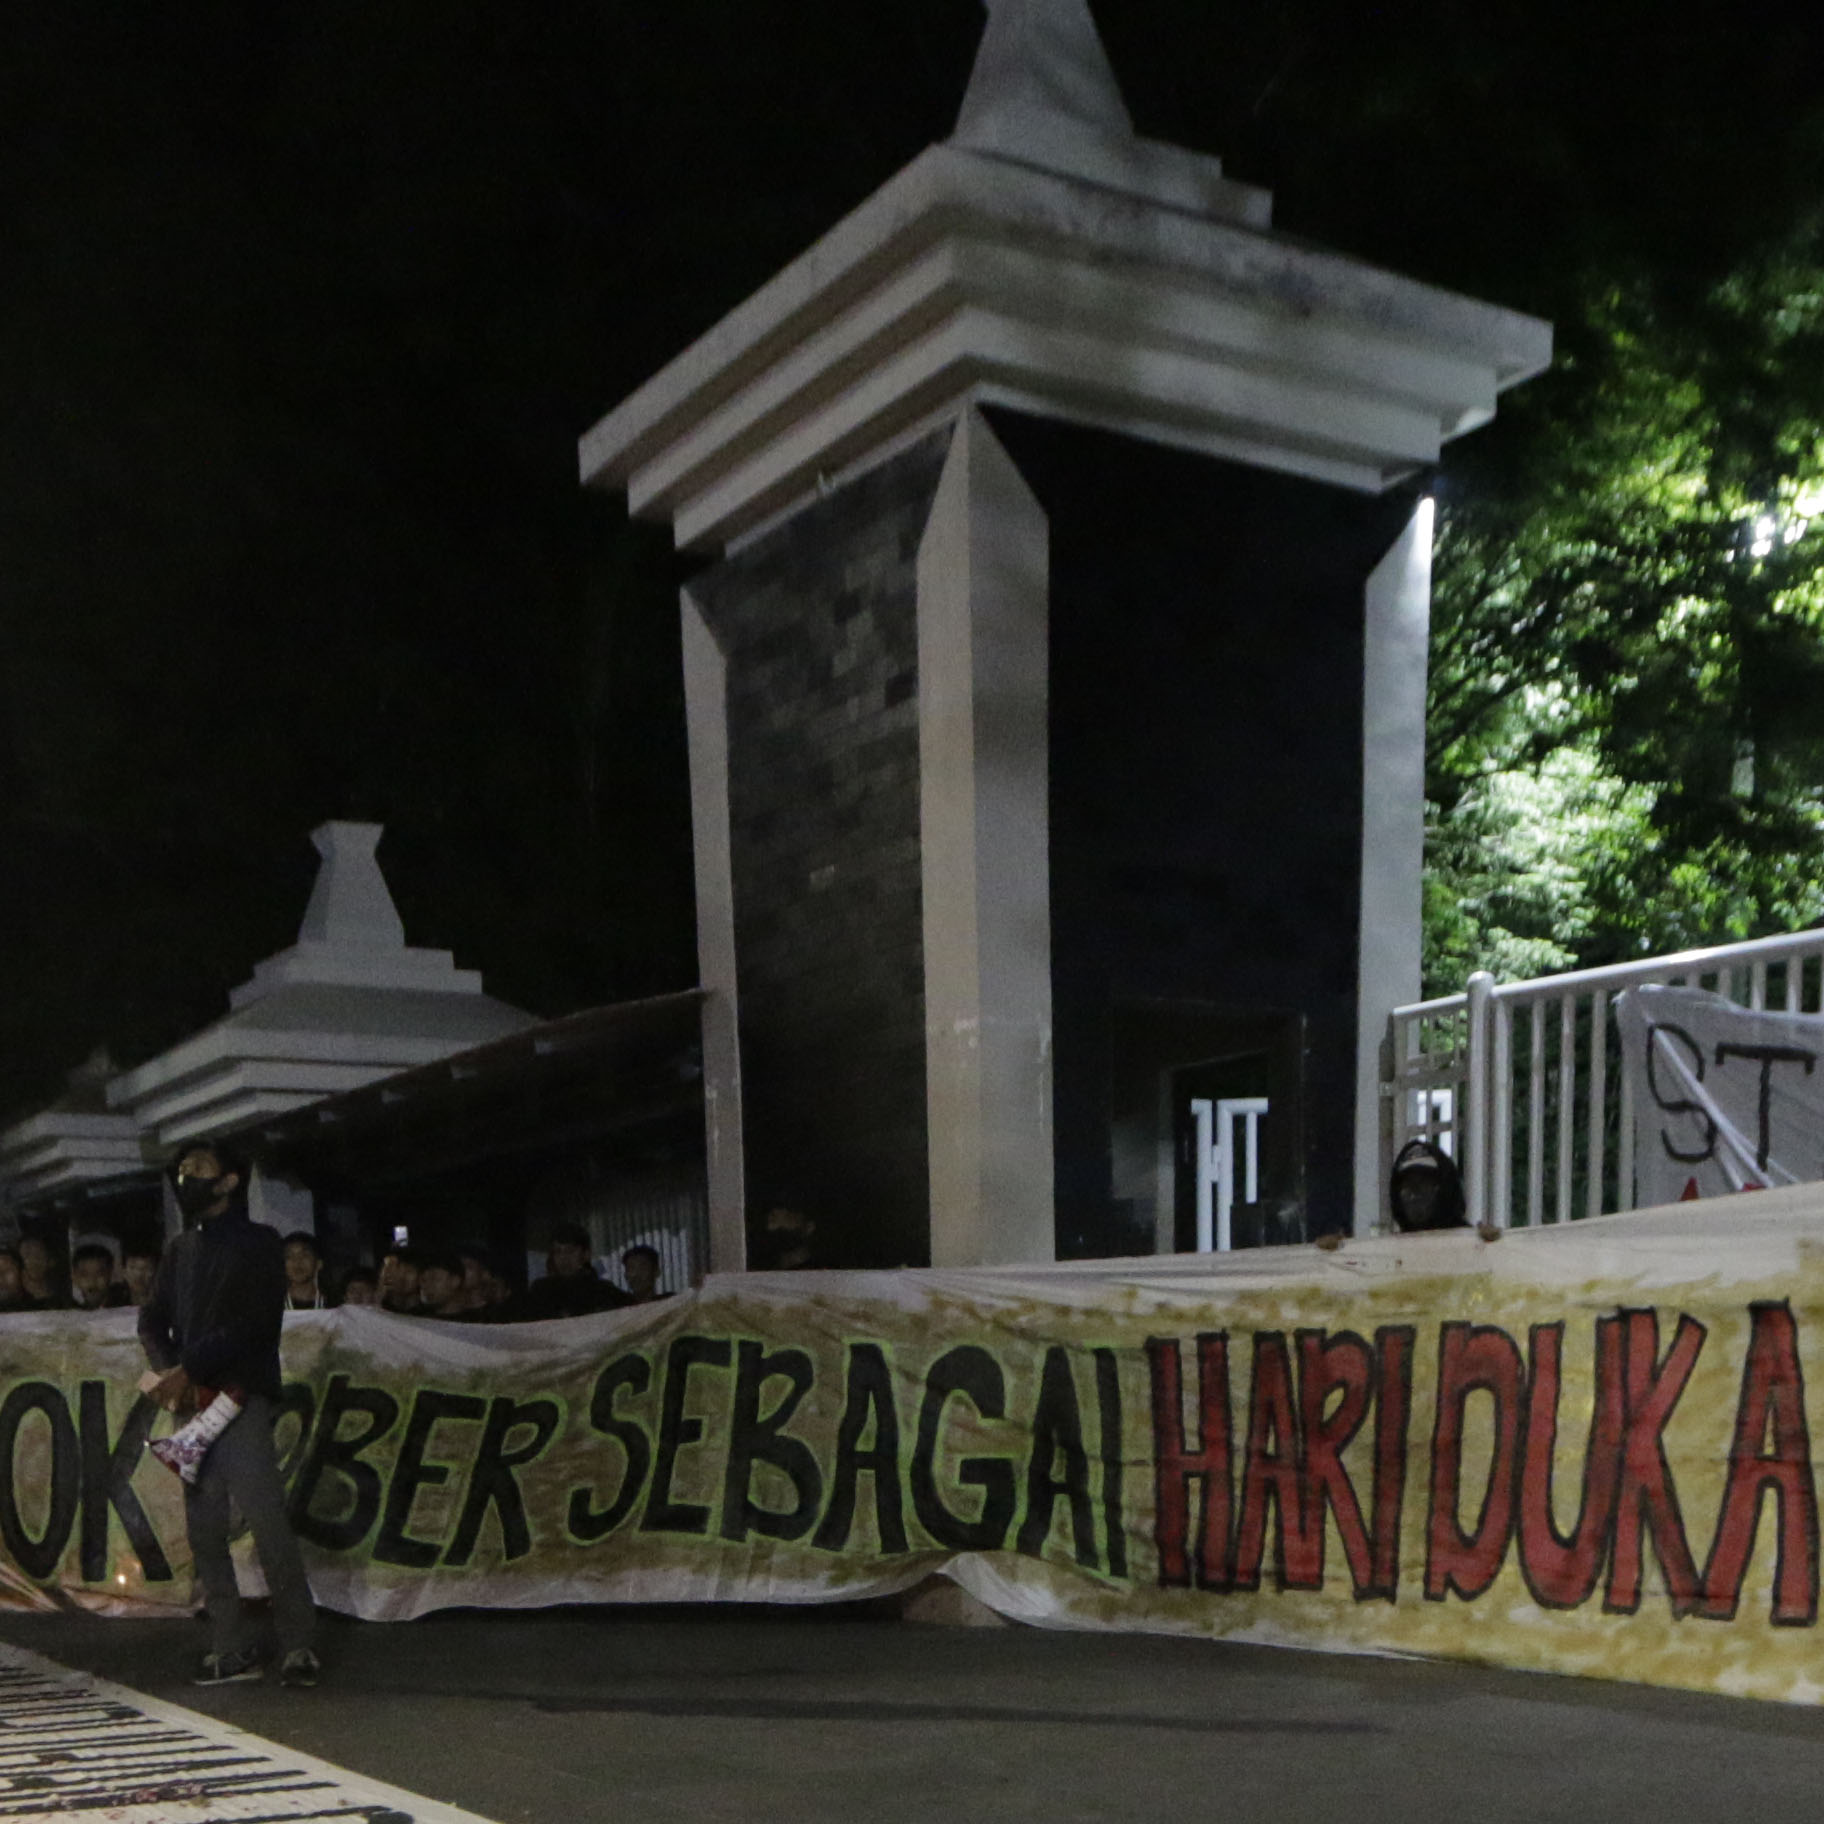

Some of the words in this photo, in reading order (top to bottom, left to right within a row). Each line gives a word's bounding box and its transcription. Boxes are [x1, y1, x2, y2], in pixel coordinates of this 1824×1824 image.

[568, 1336, 1127, 1575] SEBAGAI
[1147, 1325, 1415, 1602] HARI
[1424, 1300, 1818, 1626] DUKA
